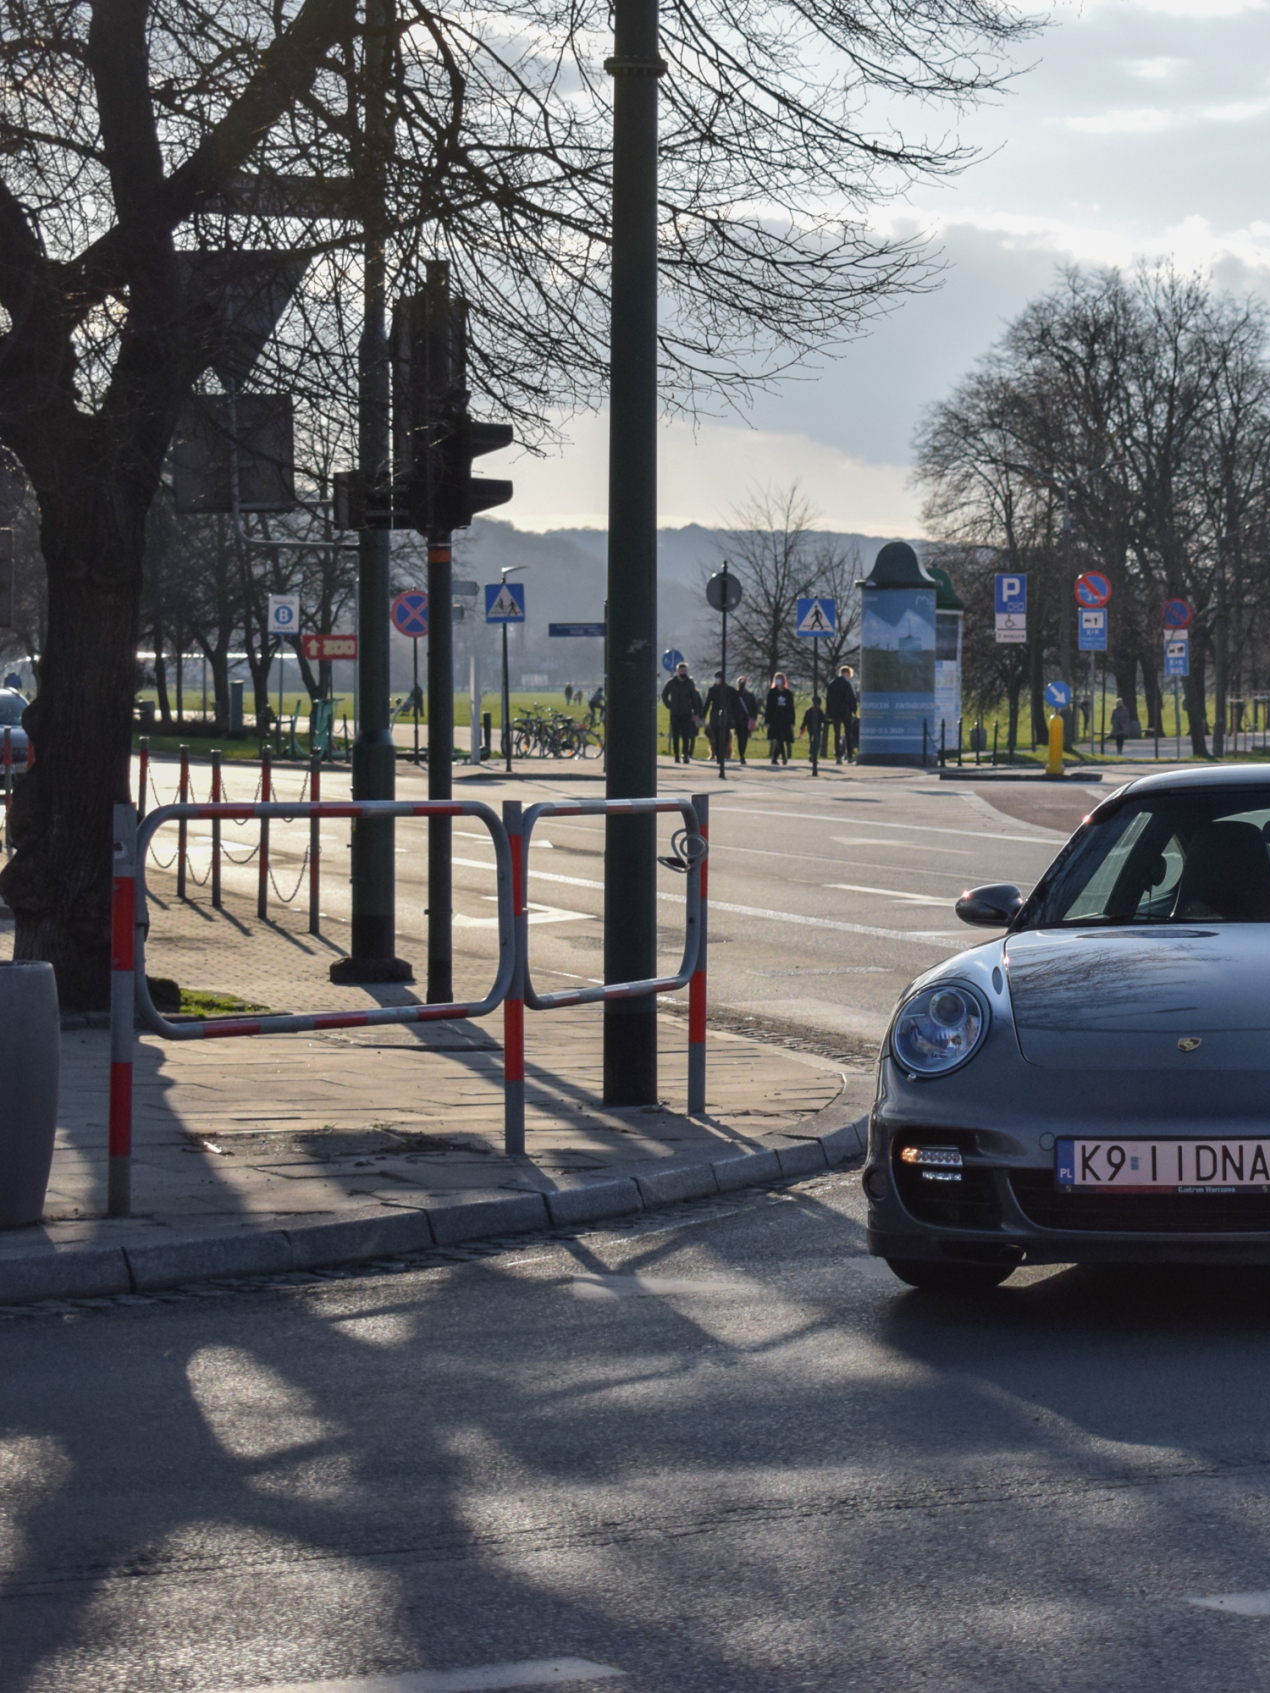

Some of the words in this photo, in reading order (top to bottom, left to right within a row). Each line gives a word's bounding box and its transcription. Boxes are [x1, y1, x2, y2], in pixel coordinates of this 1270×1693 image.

[1002, 578, 1020, 602] P
[279, 608, 289, 622] B
[1081, 1145, 1126, 1181] K9
[1060, 1168, 1073, 1178] PL
